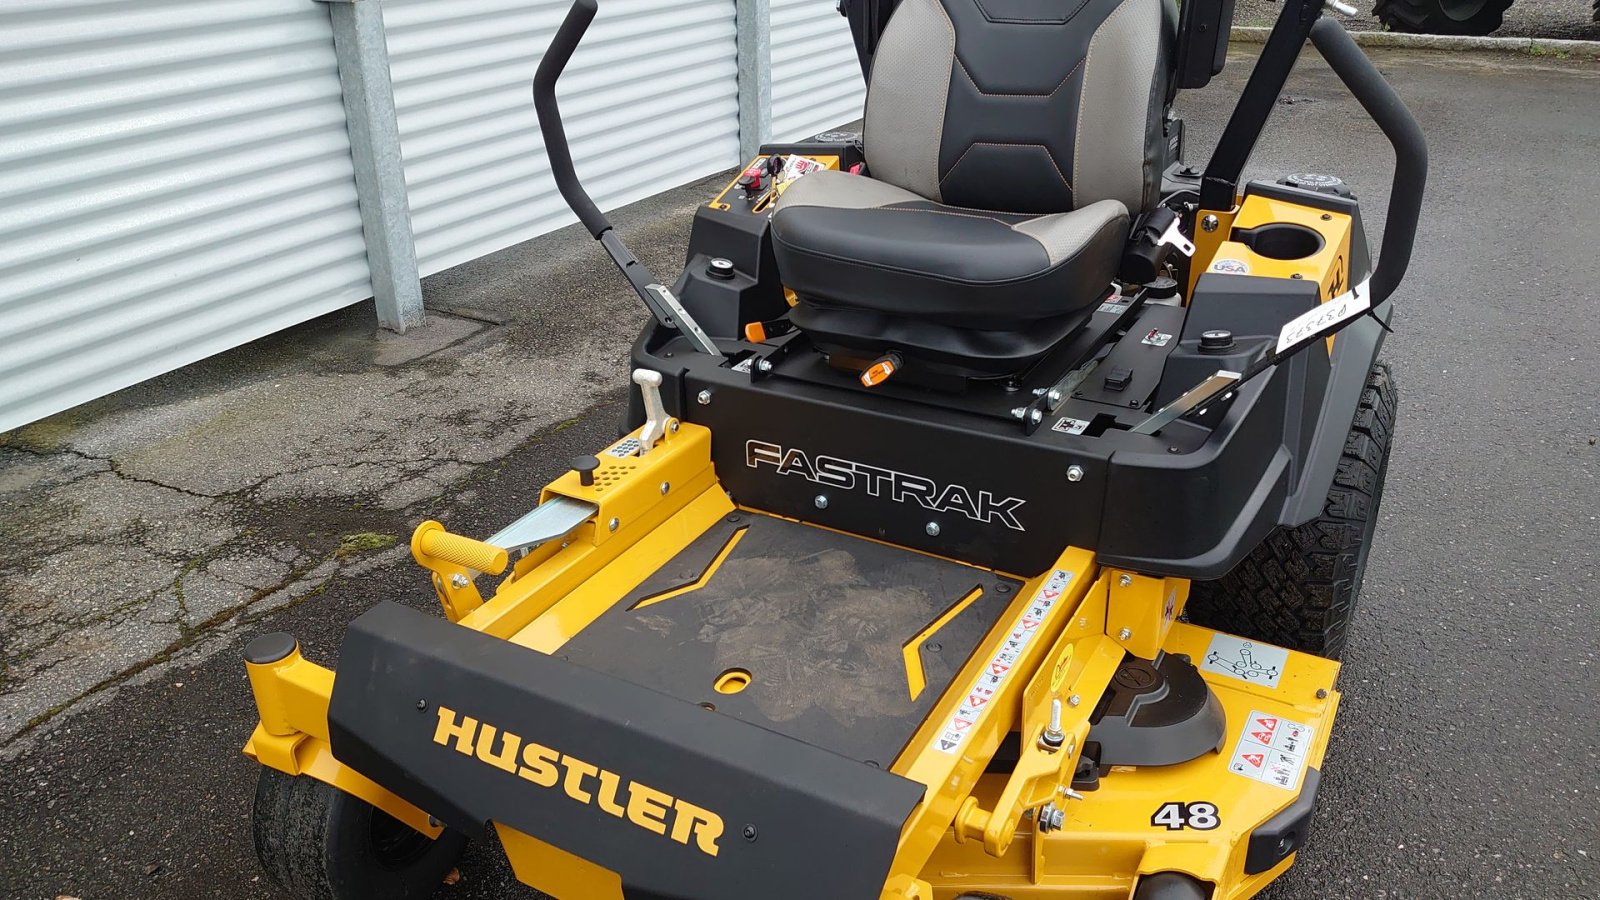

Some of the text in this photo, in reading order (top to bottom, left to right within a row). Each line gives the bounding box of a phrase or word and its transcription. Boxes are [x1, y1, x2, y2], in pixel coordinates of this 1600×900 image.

[1214, 264, 1246, 273] USA
[746, 439, 1027, 532] FASTRAK
[433, 706, 724, 857] HUSTLER
[1151, 802, 1221, 830] 48
